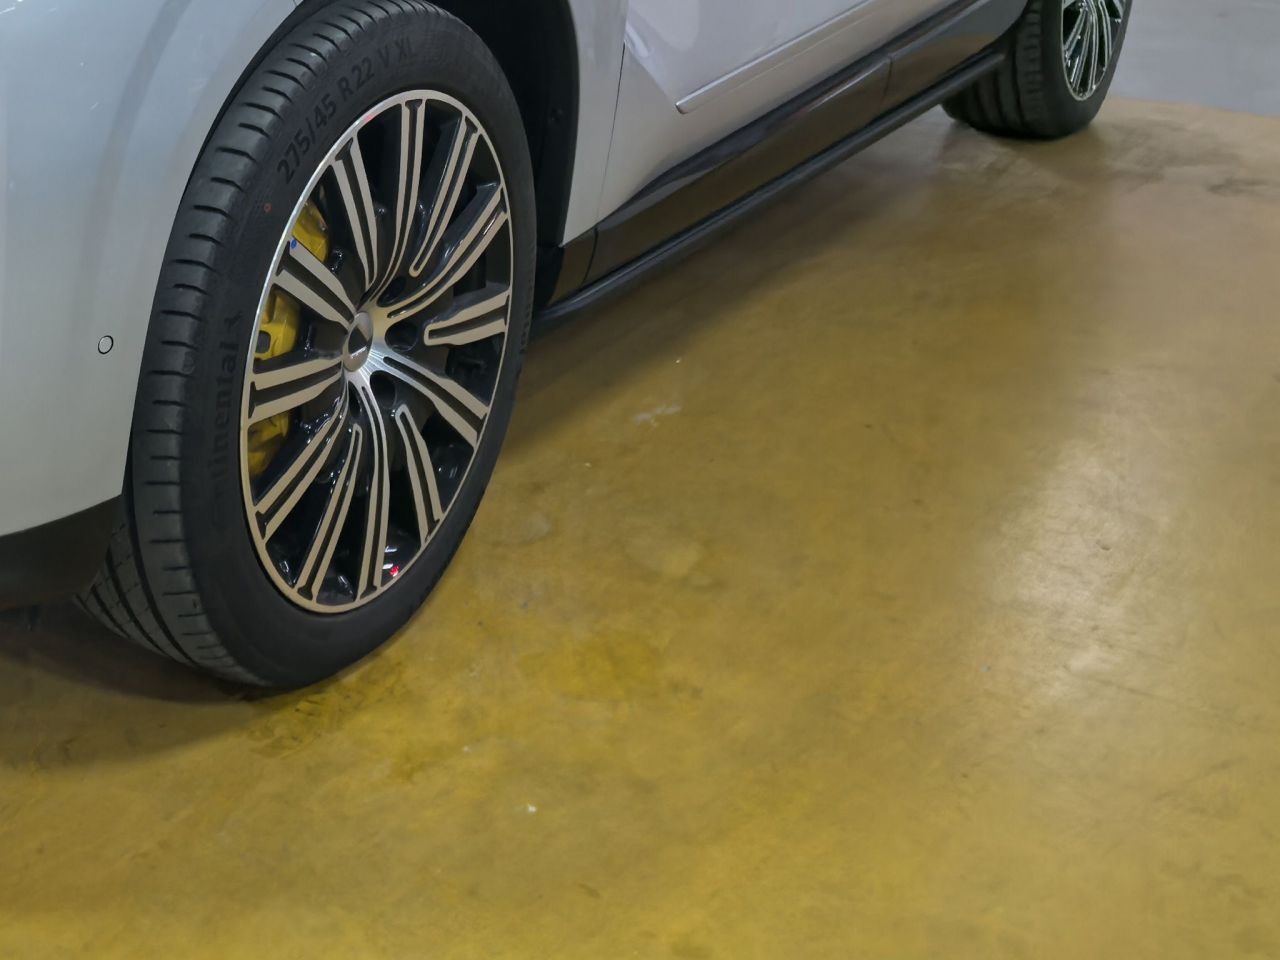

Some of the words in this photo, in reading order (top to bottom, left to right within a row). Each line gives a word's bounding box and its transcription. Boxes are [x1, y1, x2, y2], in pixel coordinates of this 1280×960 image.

[276, 94, 338, 184] 275/45
[336, 76, 354, 101] R
[351, 59, 376, 86] 22
[376, 45, 390, 69] V
[395, 38, 418, 62] XL
